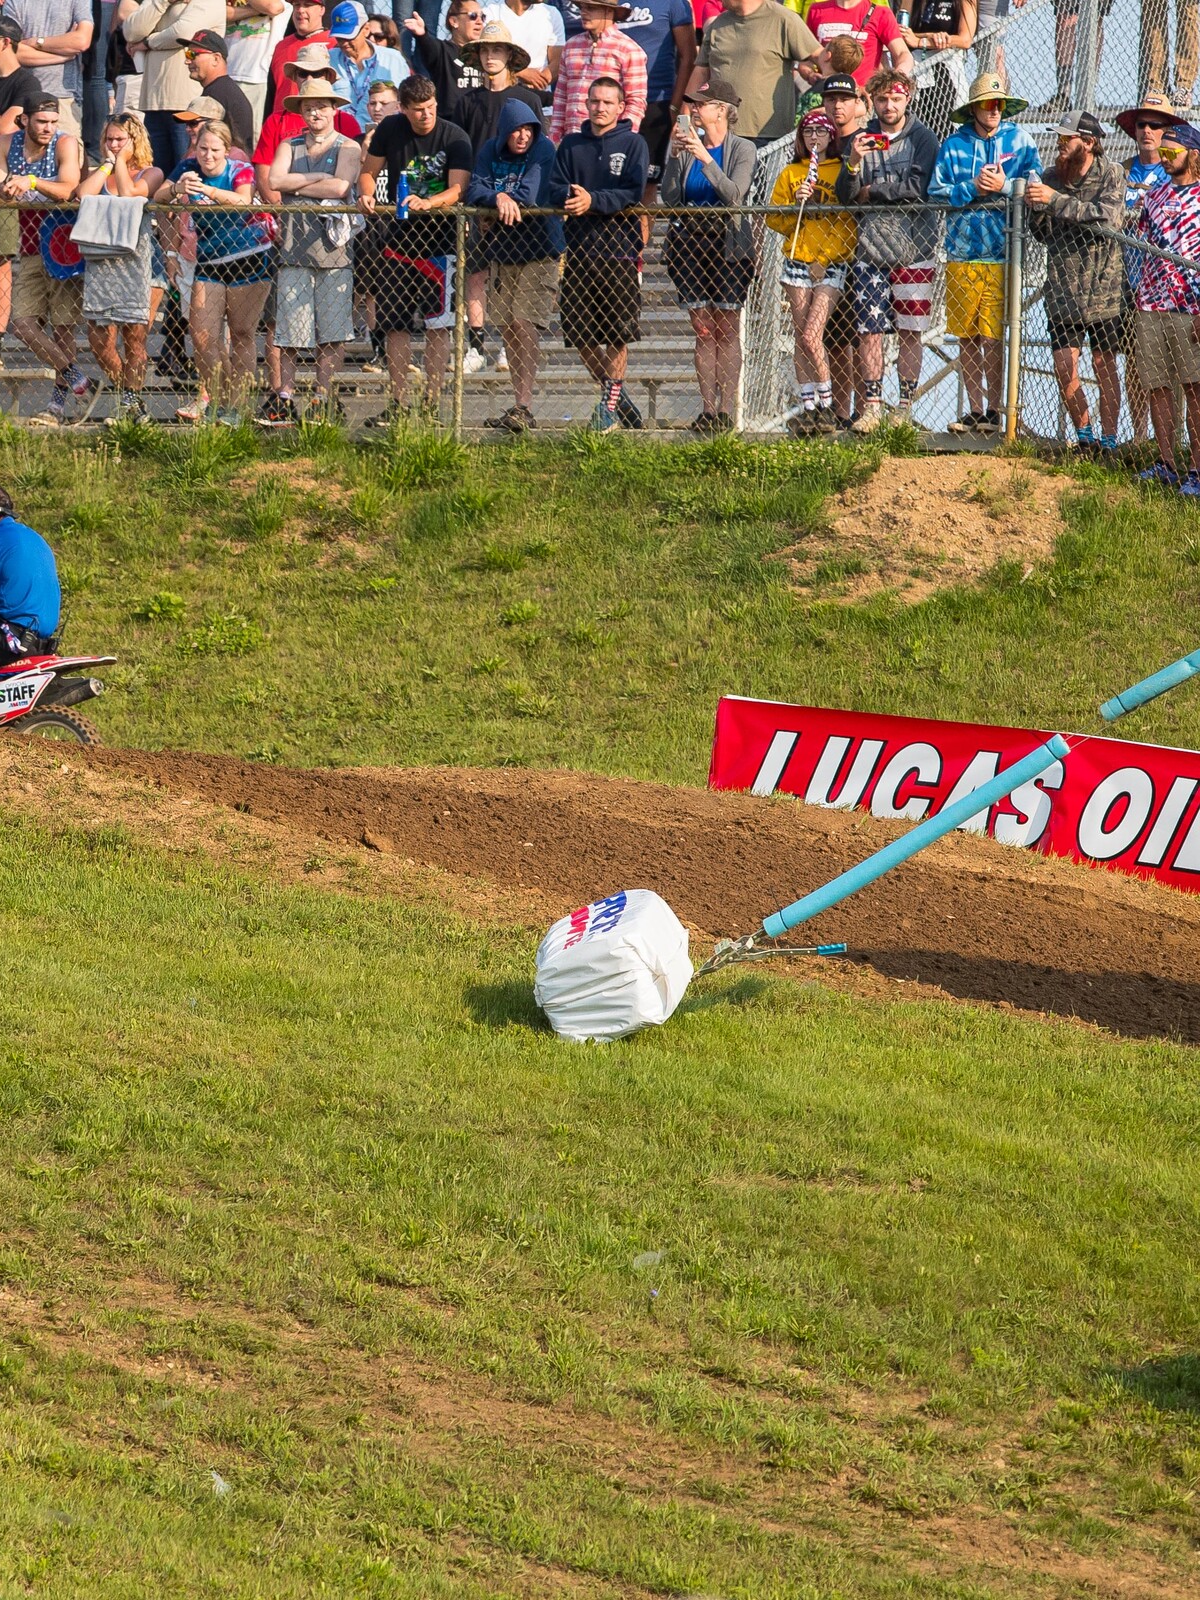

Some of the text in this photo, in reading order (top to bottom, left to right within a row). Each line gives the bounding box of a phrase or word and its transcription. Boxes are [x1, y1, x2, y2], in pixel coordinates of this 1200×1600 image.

[457, 78, 469, 88] OF
[828, 82, 852, 90] ARMA
[751, 729, 1066, 849] LUCAS
